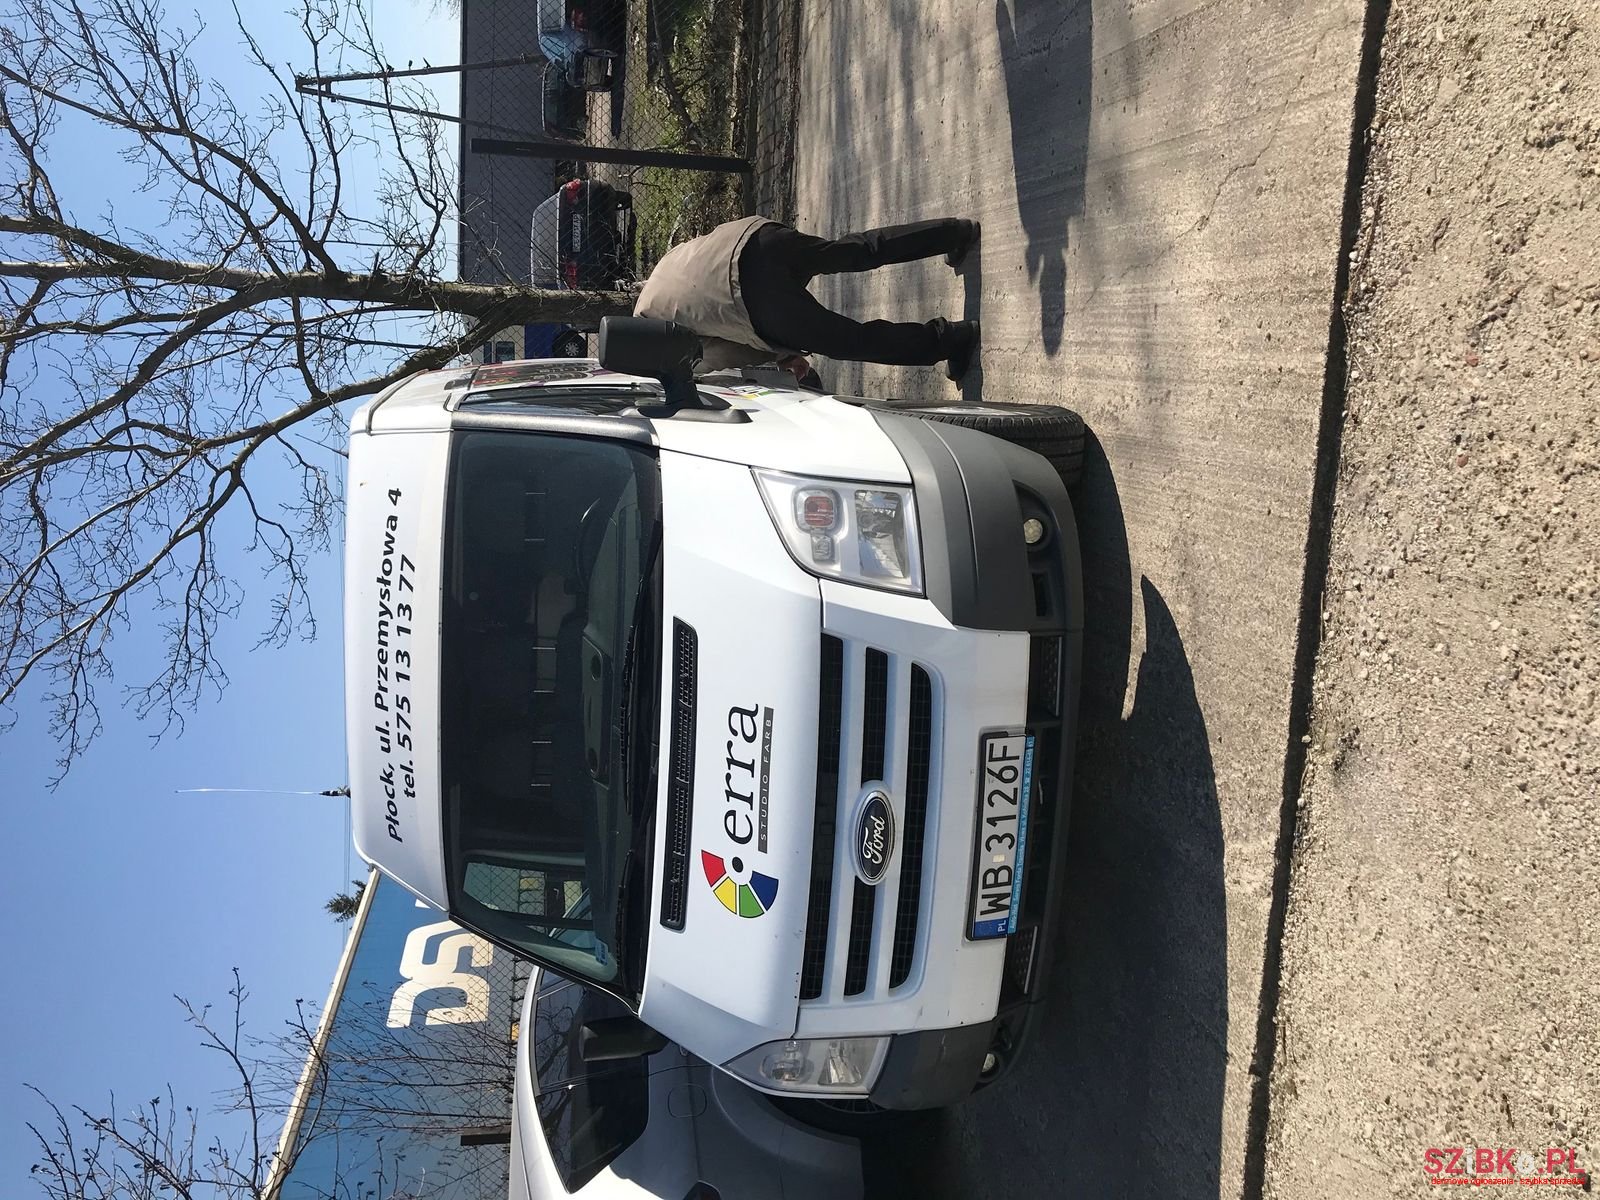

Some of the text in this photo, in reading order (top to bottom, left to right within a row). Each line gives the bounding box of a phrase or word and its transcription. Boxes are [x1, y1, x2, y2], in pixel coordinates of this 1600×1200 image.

[374, 487, 403, 843] Płock, ul. Przemysłowa 4
[396, 553, 416, 799] tel. 575 13 13 77
[760, 718, 772, 841] STUDIO FARB
[862, 815, 885, 864] Ford
[980, 742, 1020, 916] WB 3126F
[998, 920, 1007, 932] PL
